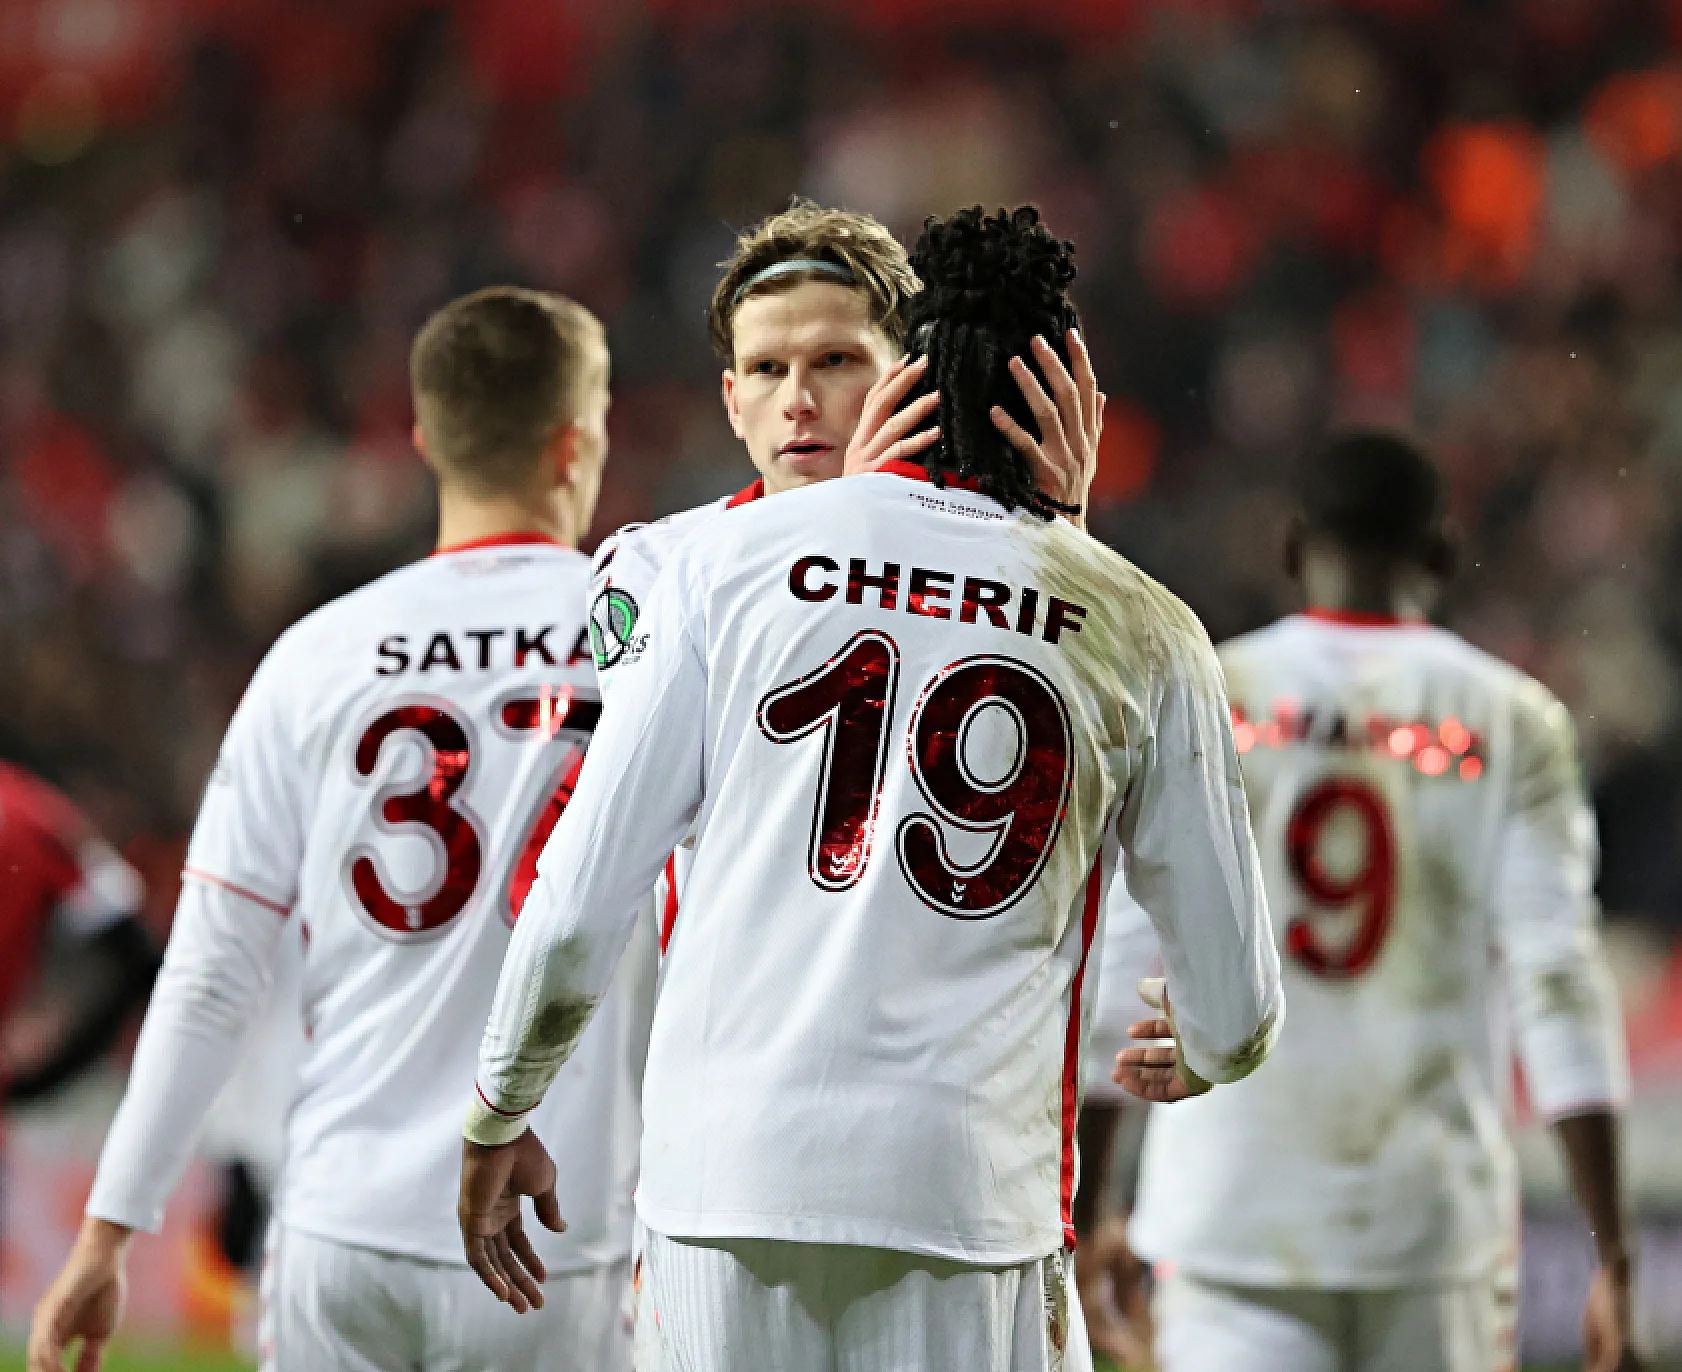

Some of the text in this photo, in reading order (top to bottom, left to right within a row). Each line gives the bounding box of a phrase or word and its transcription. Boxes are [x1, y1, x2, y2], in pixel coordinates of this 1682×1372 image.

[788, 553, 1088, 645] CHERIF
[344, 694, 603, 944] 37
[756, 628, 1075, 921] 19
[1284, 773, 1398, 981] 9
